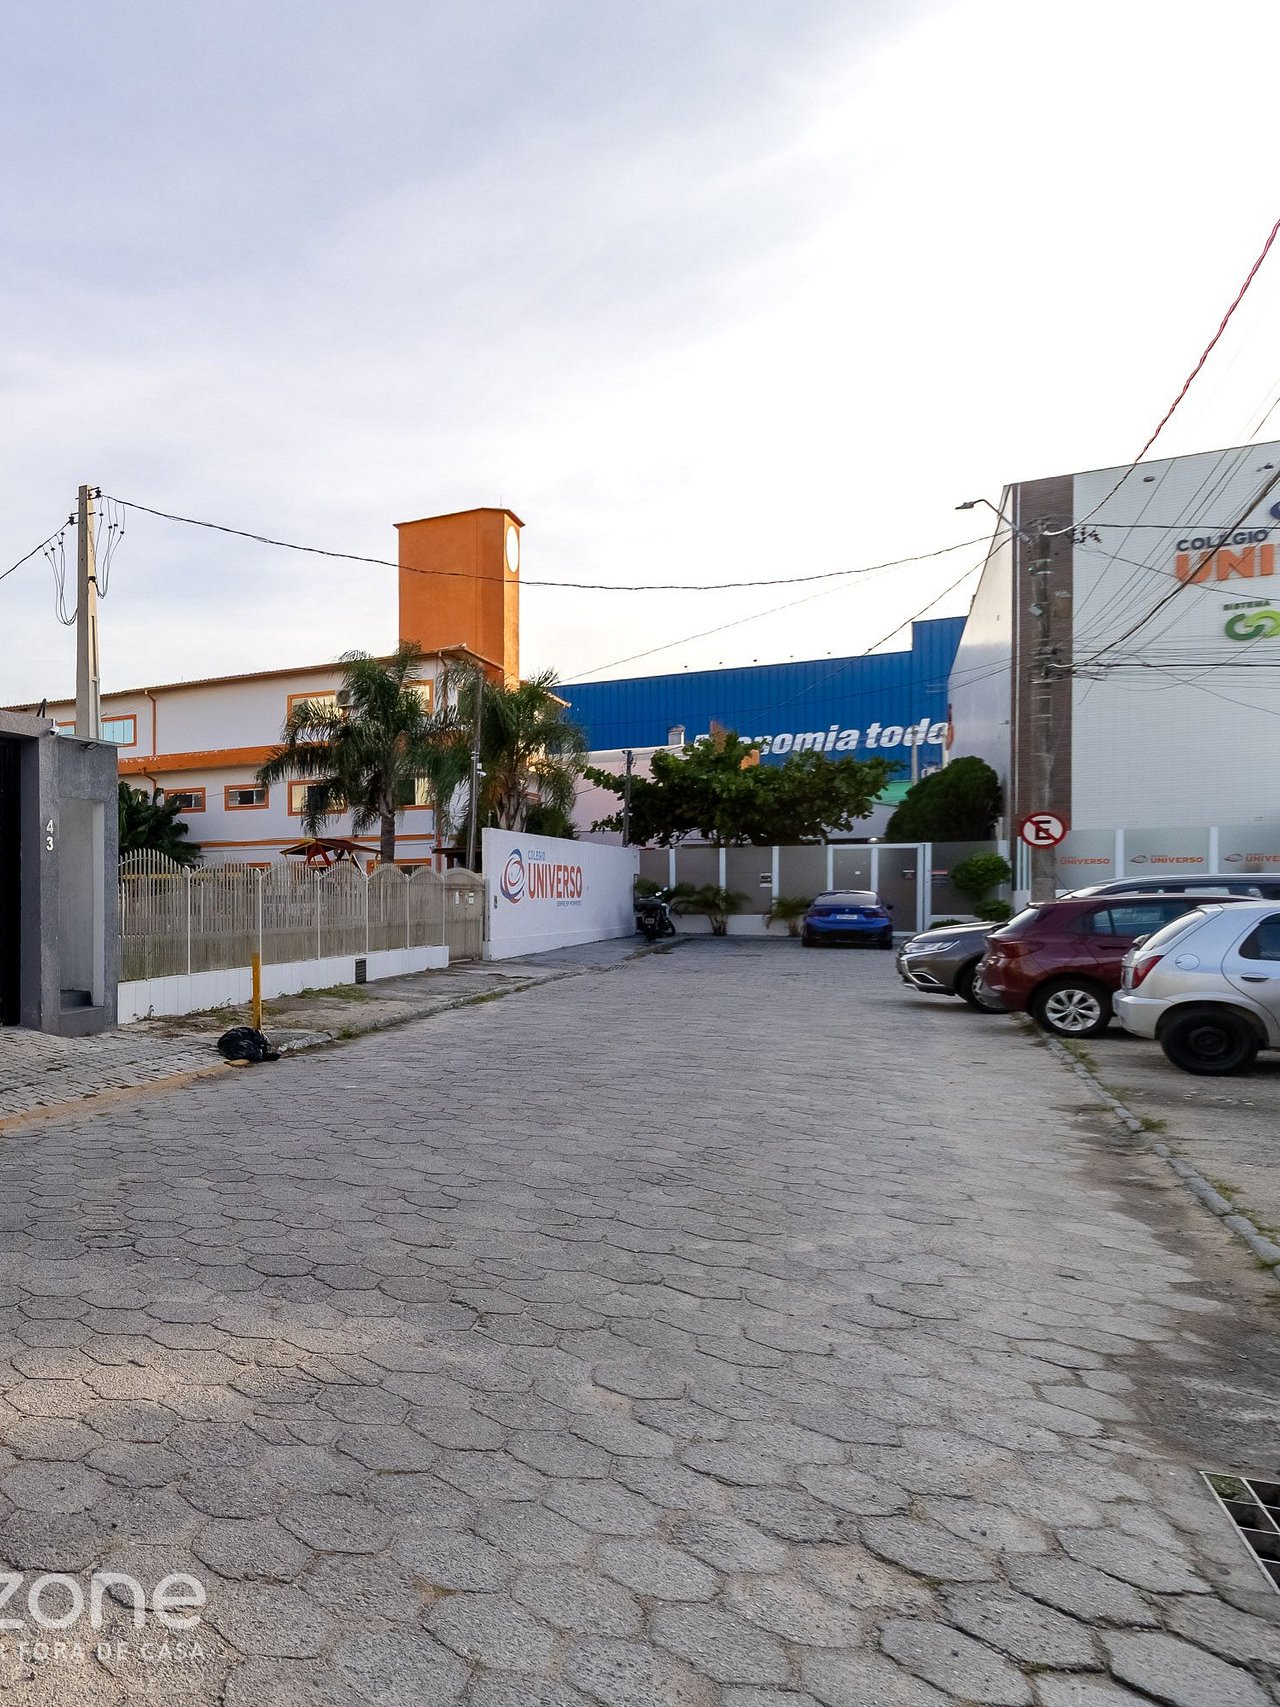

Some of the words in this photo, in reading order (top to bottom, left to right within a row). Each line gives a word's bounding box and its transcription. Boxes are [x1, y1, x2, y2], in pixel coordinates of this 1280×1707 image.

[865, 717, 949, 748] todo
[46, 819, 54, 851] 43
[1060, 857, 1110, 865] UNIVERSO
[1150, 856, 1203, 864] UNIVERSO
[528, 863, 582, 899] UNIVERSO
